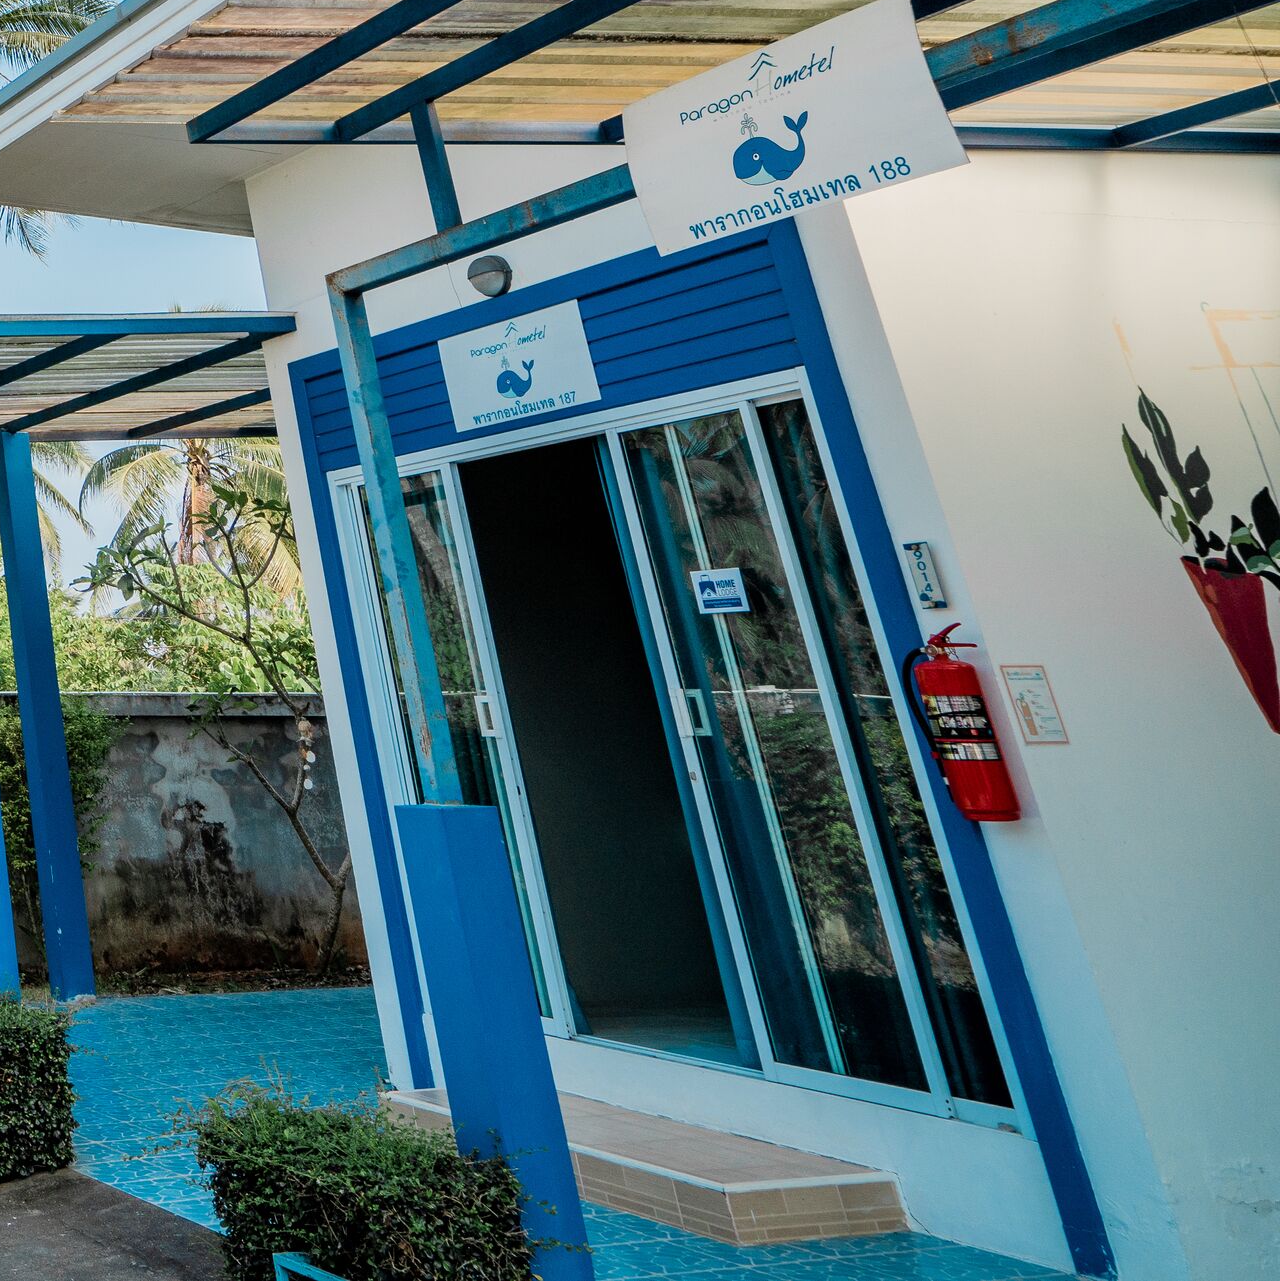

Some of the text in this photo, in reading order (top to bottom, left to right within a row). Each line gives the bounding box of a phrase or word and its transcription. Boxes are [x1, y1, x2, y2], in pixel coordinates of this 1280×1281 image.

[679, 89, 754, 126] Paragon
[754, 45, 835, 96] Hometel
[689, 156, 912, 240] พารากอนโฮมเทล 188
[470, 342, 508, 358] Paragon
[508, 324, 546, 345] ometel
[472, 390, 577, 425] พารากอนโฮมเทล 187
[715, 579, 736, 589] HOME
[912, 550, 933, 593] 9014
[717, 587, 738, 597] LODGE
